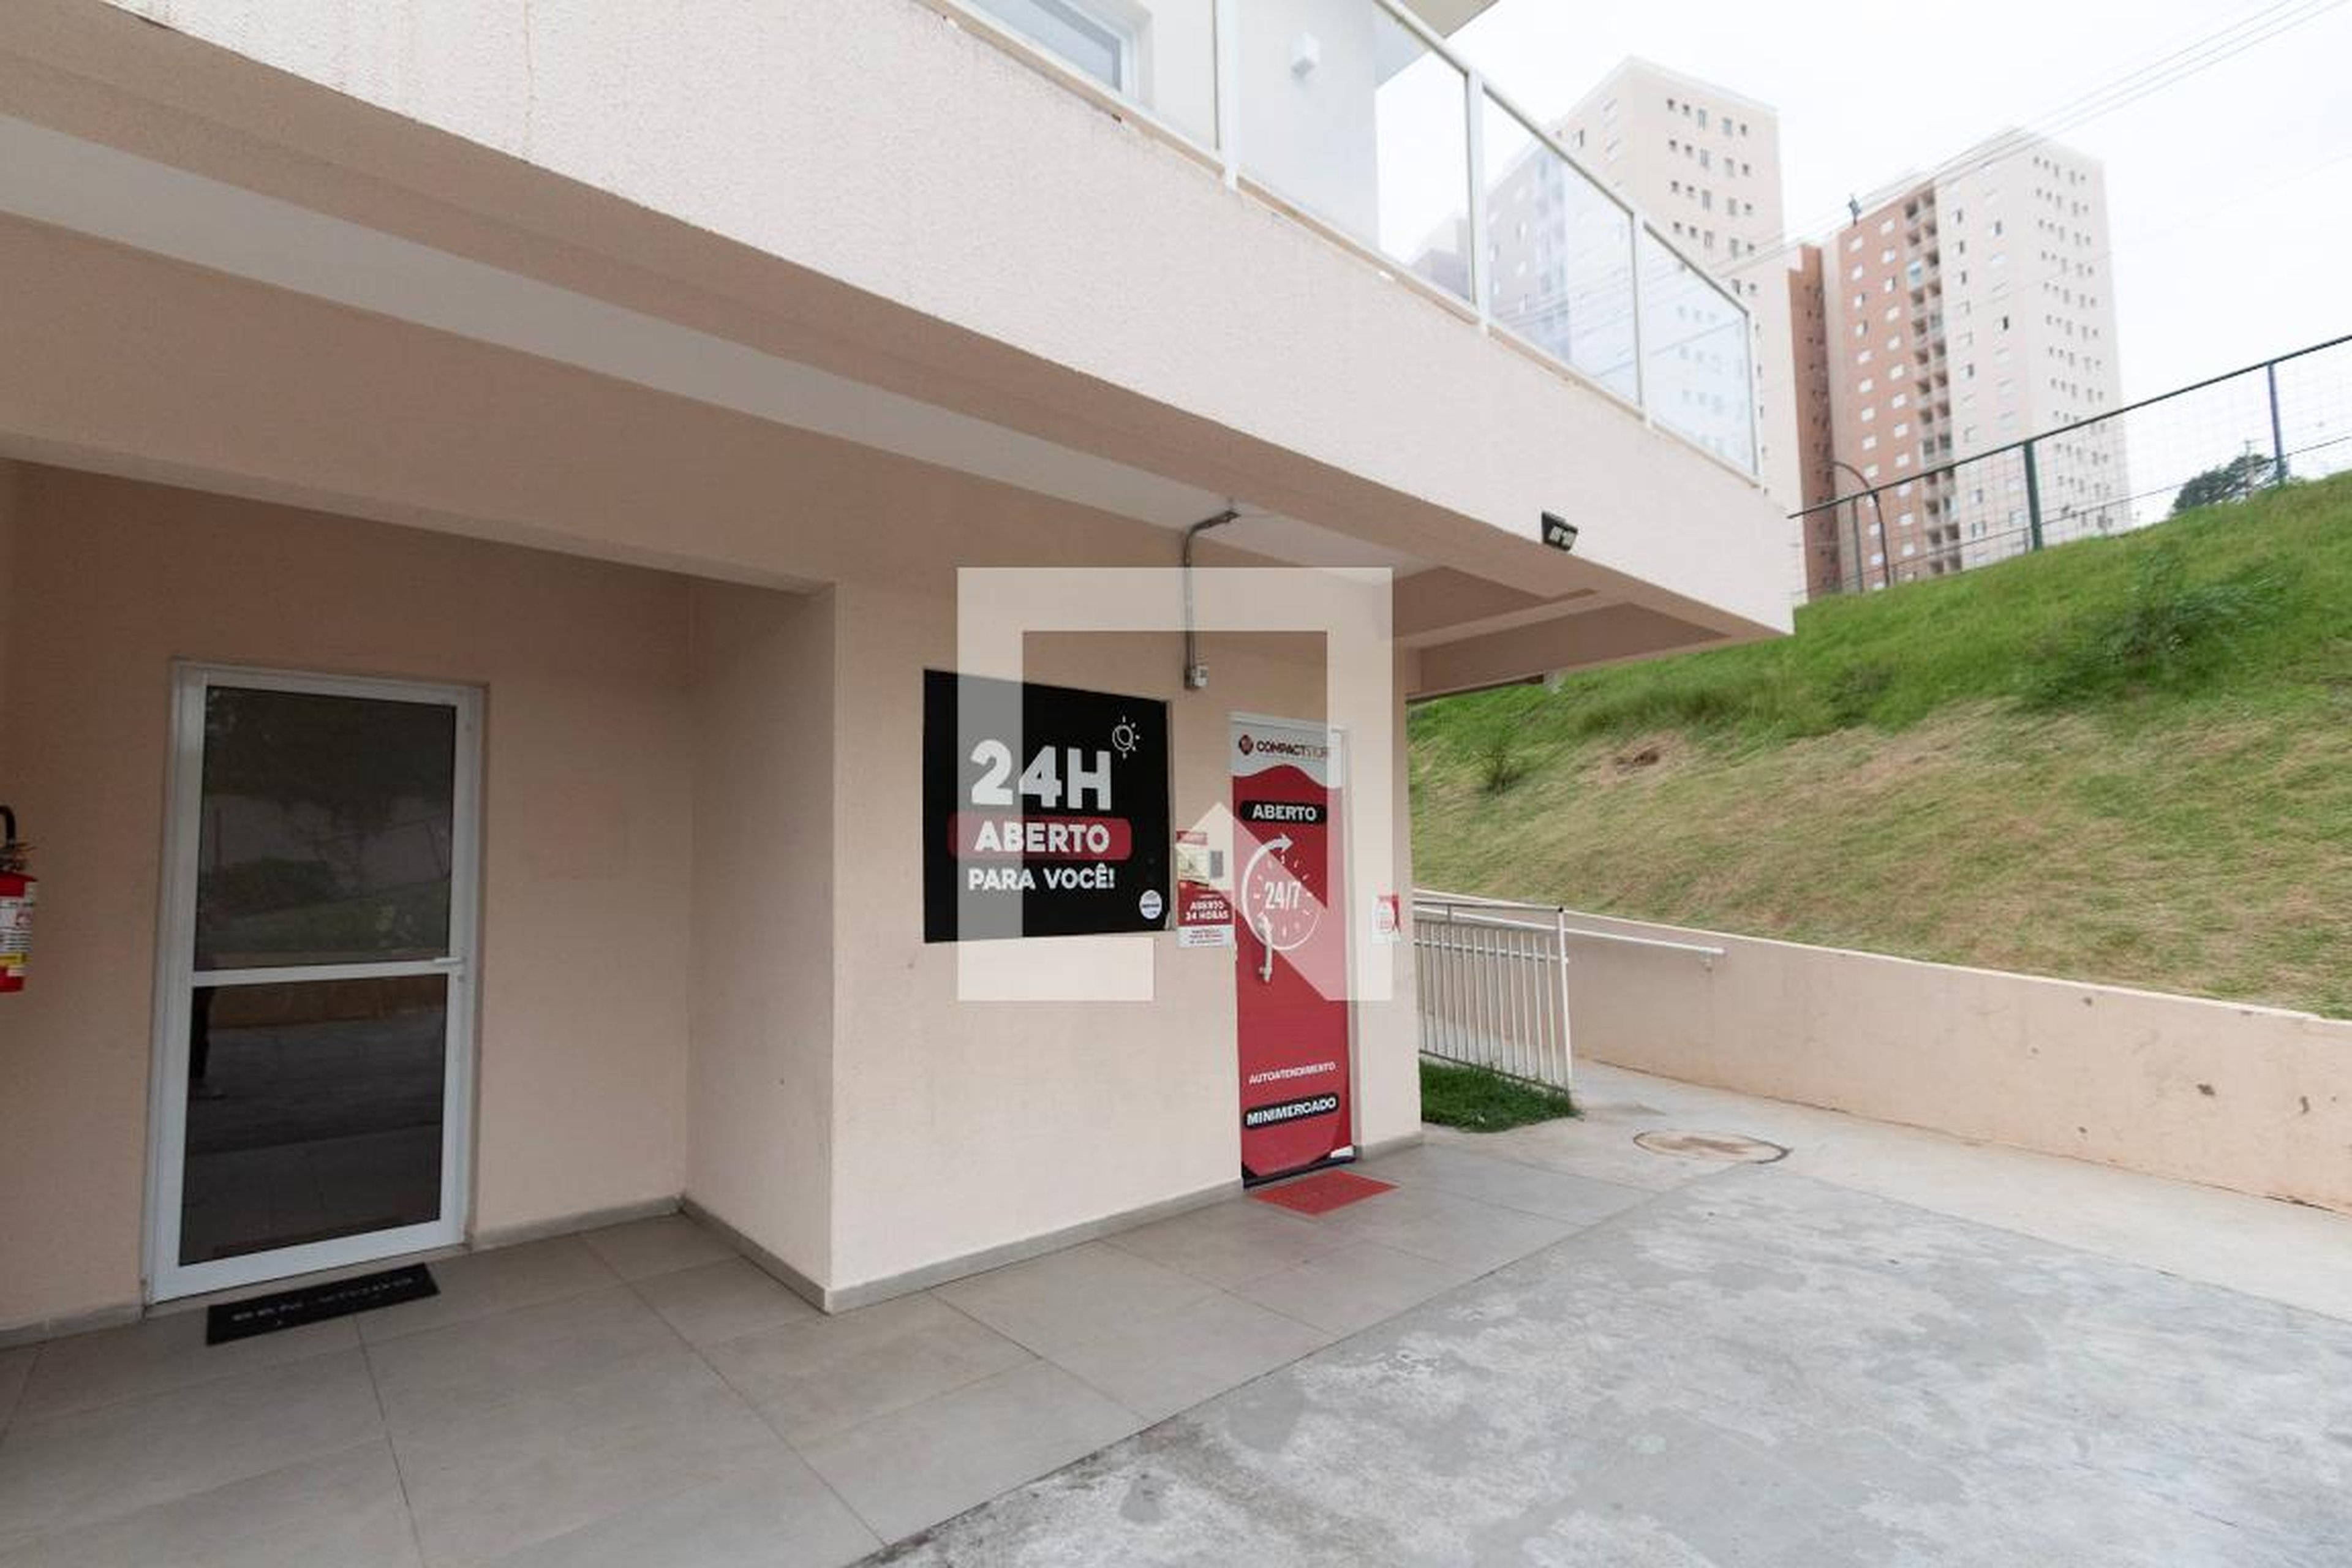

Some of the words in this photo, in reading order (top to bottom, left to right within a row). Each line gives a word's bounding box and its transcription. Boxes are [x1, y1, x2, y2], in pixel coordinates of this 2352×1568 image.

[970, 739, 1112, 810] 24H
[1252, 804, 1317, 821] ABERTO
[974, 821, 1110, 853] ABERTO
[968, 868, 1036, 890] PARA
[1044, 863, 1115, 889] VOCÊ!
[1264, 881, 1302, 910] 24/7
[1246, 1097, 1336, 1126] MINIMERCADO
